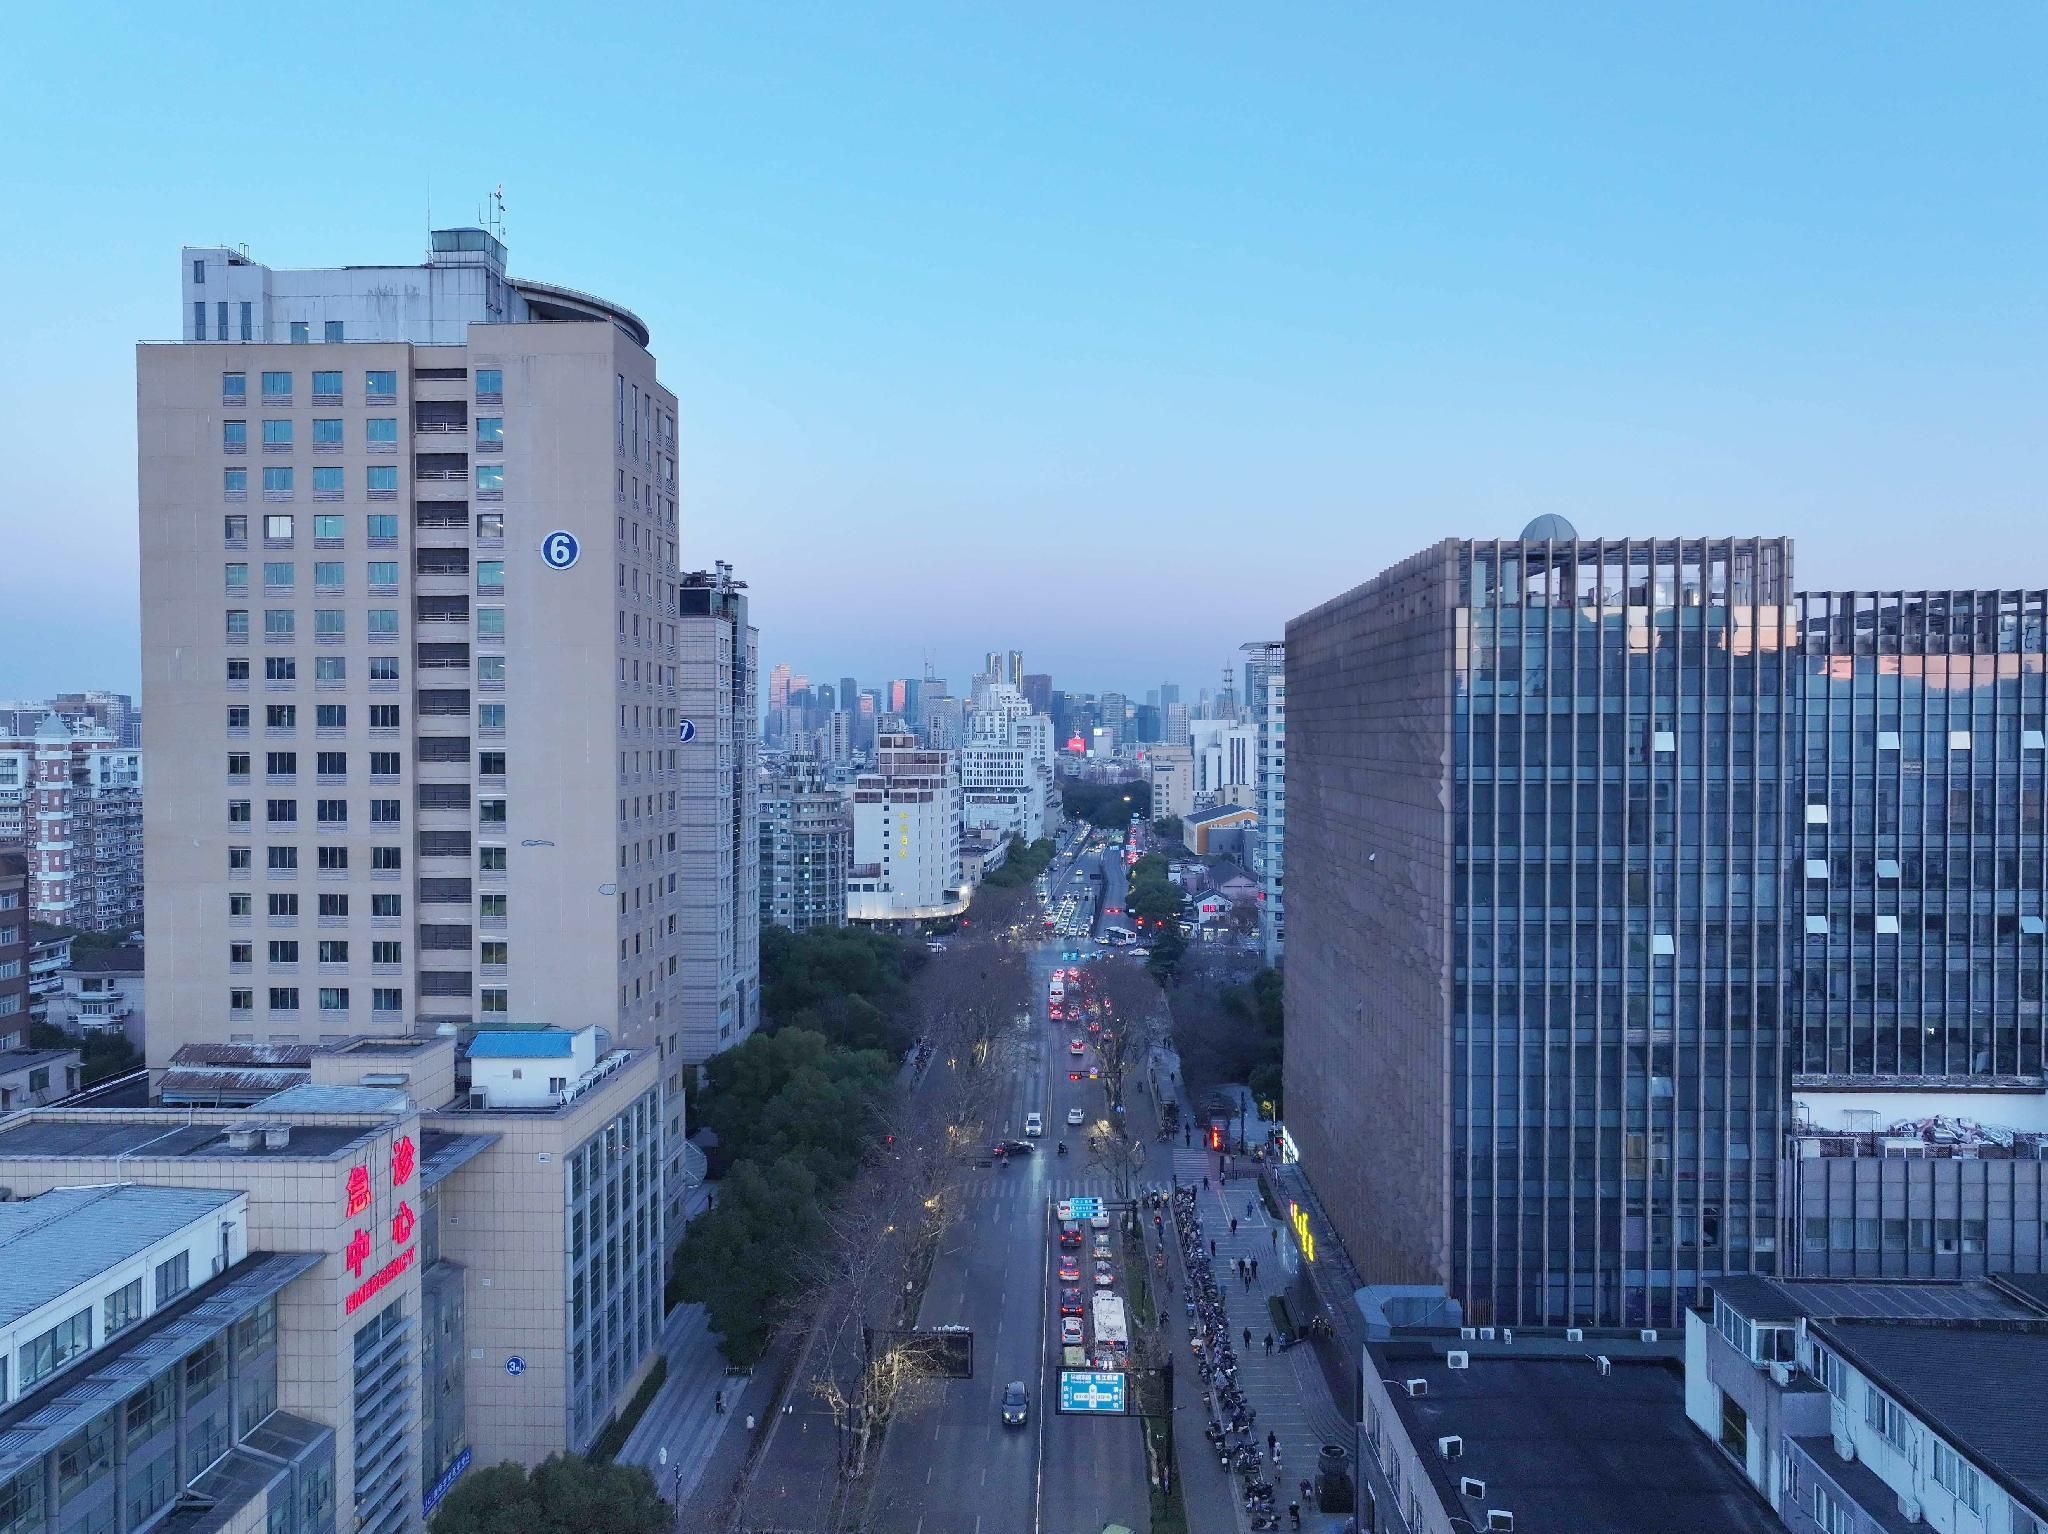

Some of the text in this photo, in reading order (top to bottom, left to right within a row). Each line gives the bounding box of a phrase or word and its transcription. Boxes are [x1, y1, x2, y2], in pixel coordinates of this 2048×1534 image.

[550, 535, 570, 563] 6
[680, 723, 688, 739] 7
[345, 1135, 416, 1218] 急诊
[345, 1200, 416, 1279] 中心
[345, 1246, 416, 1316] EMERGENCY
